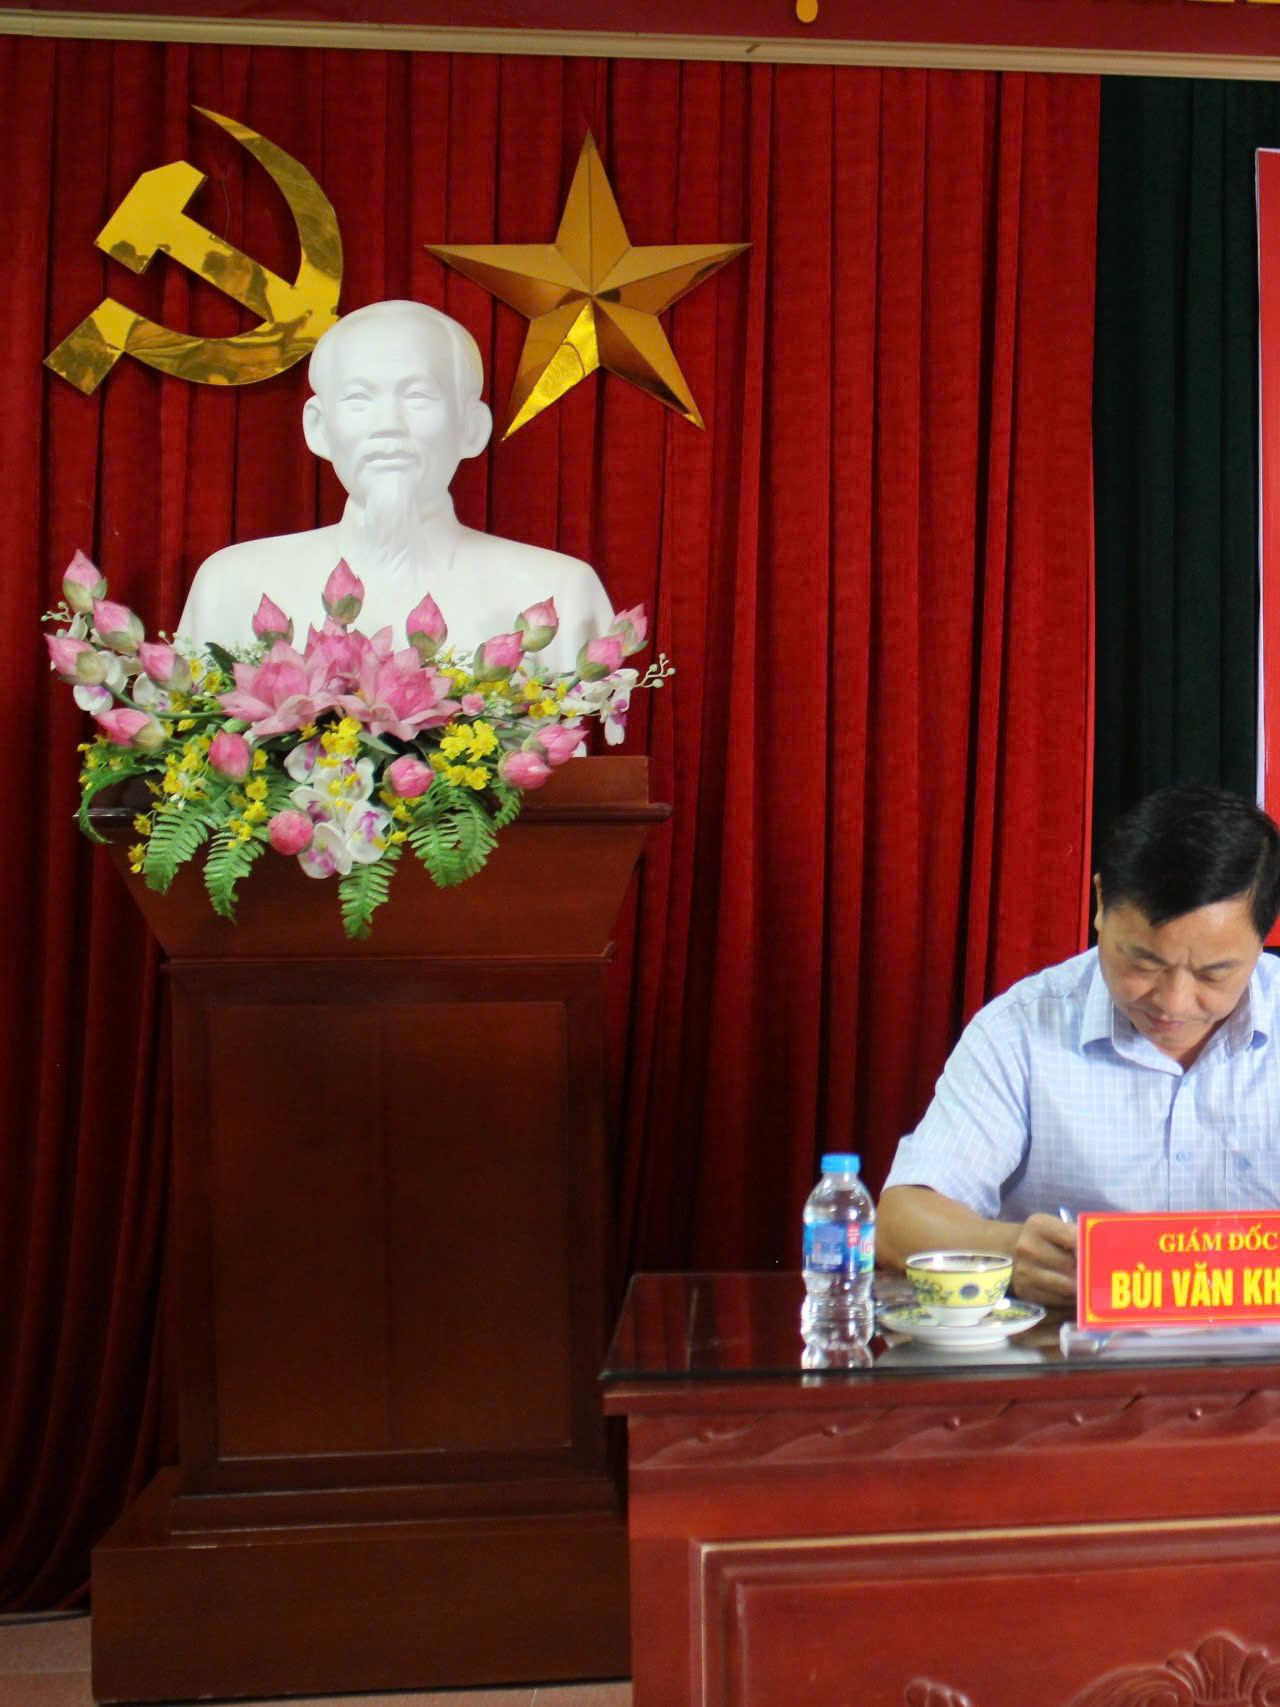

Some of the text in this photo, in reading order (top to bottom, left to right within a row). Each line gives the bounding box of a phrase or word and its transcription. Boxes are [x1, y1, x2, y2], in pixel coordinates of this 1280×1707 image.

[1158, 1224, 1279, 1253] GIÁM ĐỐC
[1111, 1262, 1162, 1309] BÙI
[1171, 1261, 1234, 1308] VĂN
